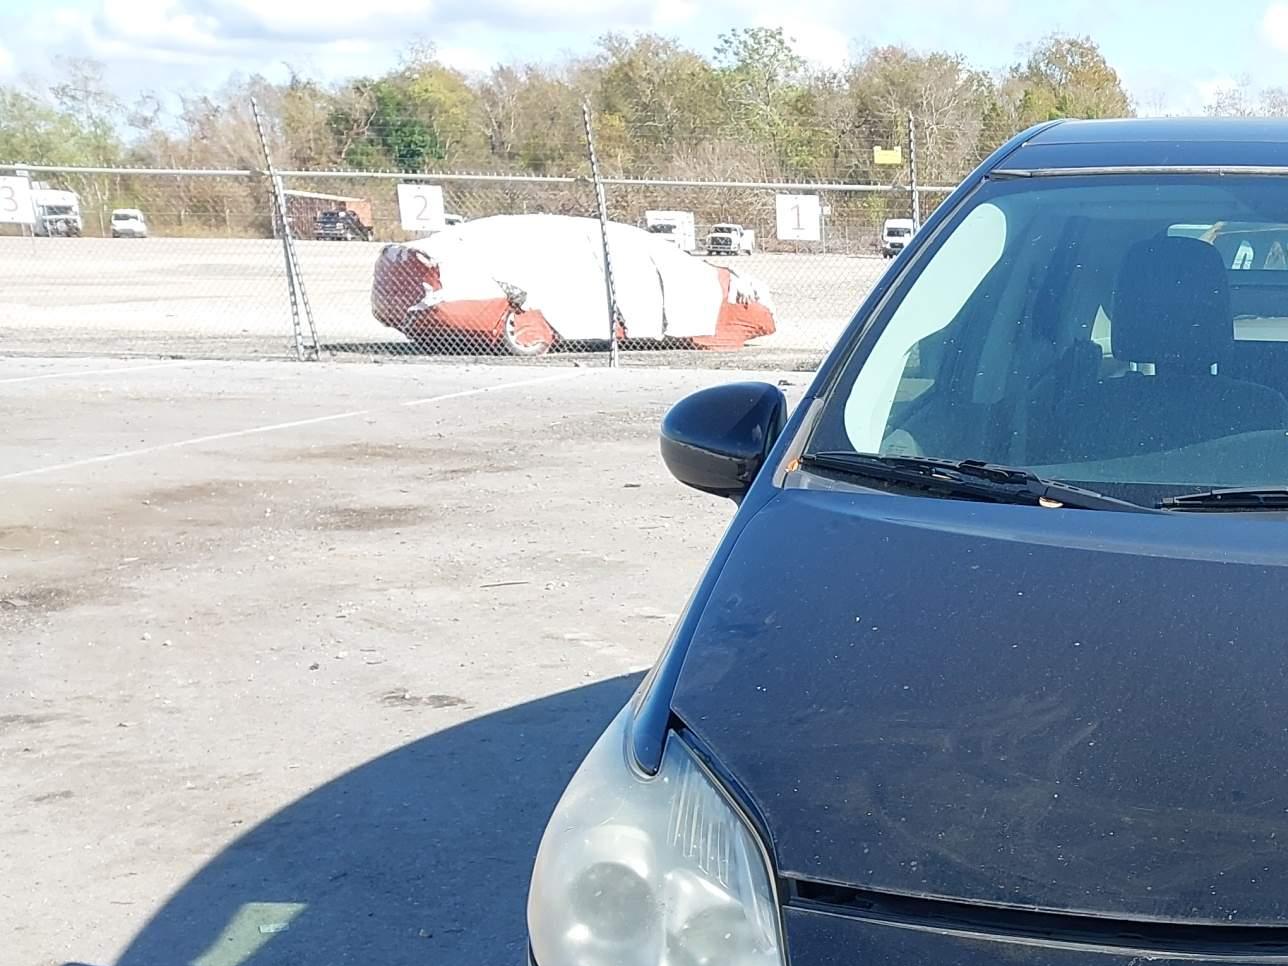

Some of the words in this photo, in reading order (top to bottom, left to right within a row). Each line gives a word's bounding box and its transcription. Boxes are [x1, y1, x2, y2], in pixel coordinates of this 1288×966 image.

[0, 185, 19, 212] 3
[413, 194, 431, 221] 2
[790, 204, 806, 231] 1
